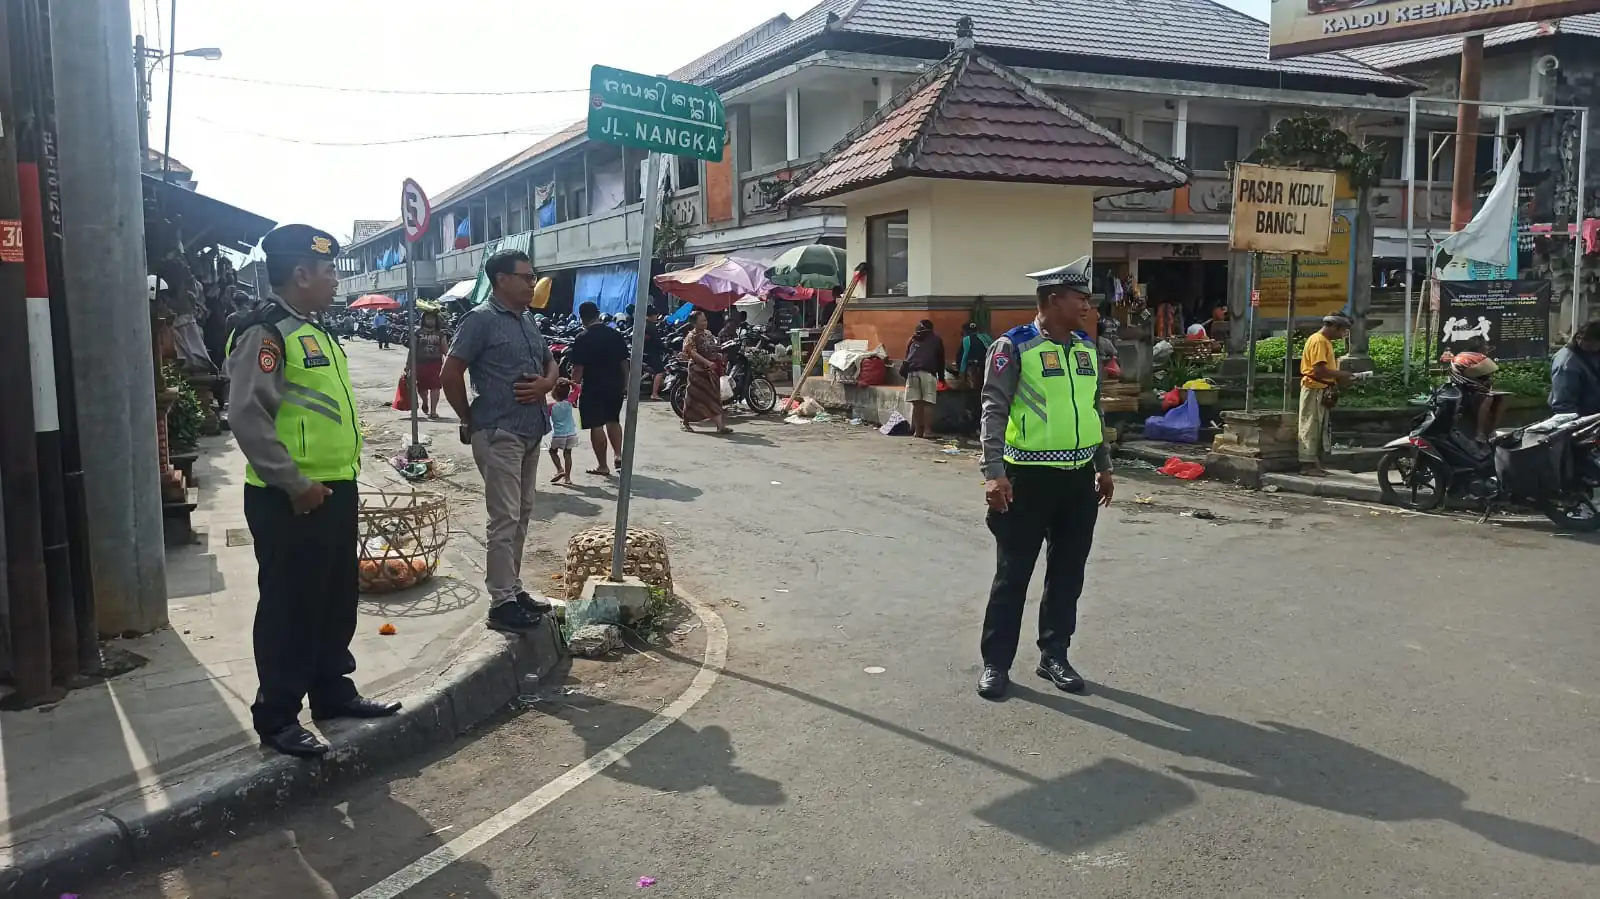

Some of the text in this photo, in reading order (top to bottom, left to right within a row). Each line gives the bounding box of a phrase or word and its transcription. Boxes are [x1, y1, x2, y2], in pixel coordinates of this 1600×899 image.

[1323, 9, 1389, 34] KALDU
[601, 116, 717, 155] JL. NANGKA
[1239, 179, 1329, 208] PASAR KIDUL
[1255, 210, 1307, 235] BANGLI
